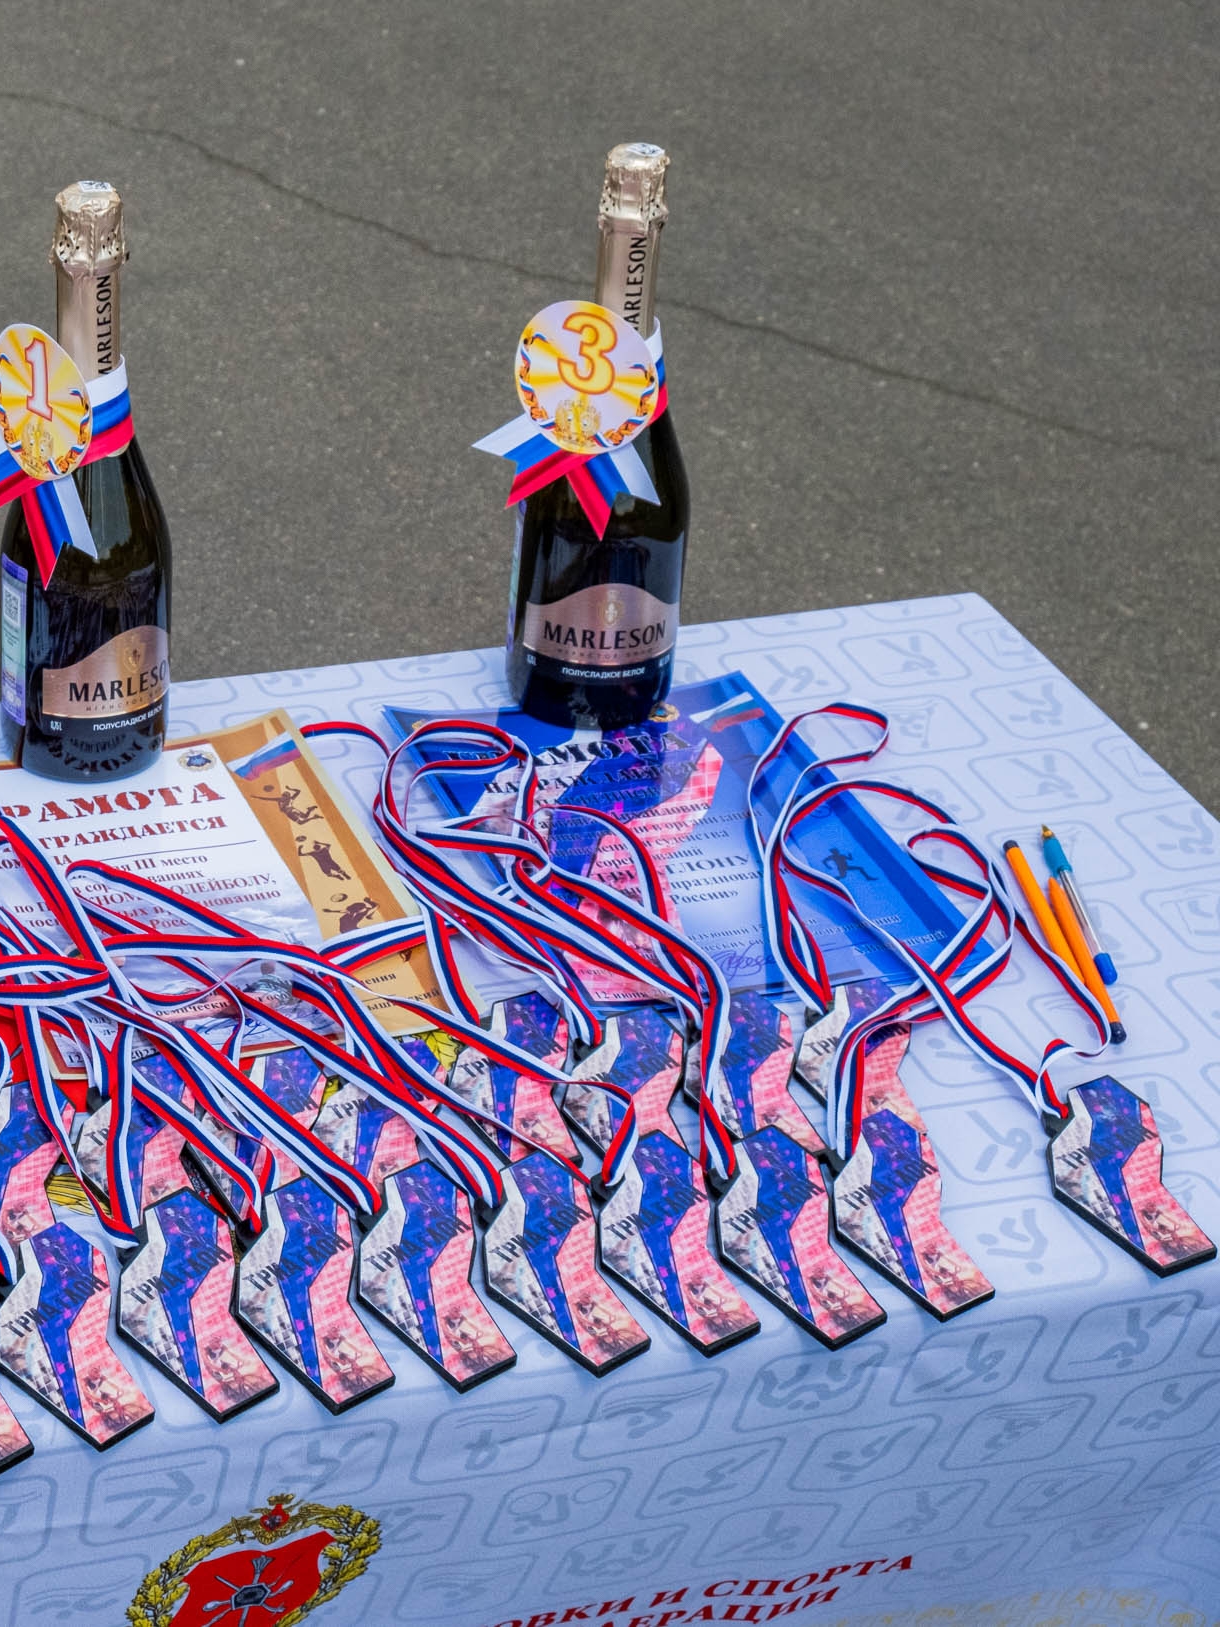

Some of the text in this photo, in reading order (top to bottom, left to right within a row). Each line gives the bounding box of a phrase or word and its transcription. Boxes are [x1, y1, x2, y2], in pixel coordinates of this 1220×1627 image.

[624, 237, 647, 336] ARLESON
[24, 338, 53, 422] 1
[557, 312, 618, 395] 3
[544, 620, 666, 650] MARLESON
[69, 659, 167, 703] MARLESO
[561, 666, 646, 679] ПОЛУСЛАДКОЕ БЕЛОЕ
[93, 713, 147, 732] ПОЛУСЛАДКОЕ
[37, 815, 227, 850] ГРАЖДАЕТСЯ
[159, 854, 208, 868] место
[169, 872, 277, 896] ОЛЕЙБОЛУ,
[604, 1185, 708, 1241] ТРИАТЛОН
[724, 1179, 826, 1235] ТРИАТЛОН
[838, 1159, 938, 1211] ТРИАТЛОН
[362, 1215, 472, 1274] ТРИАТЛОН
[489, 1202, 592, 1264] ТРИАТЛОН
[124, 1245, 232, 1305] ТРИАТЛОН
[242, 1230, 353, 1293] ТРИАТЛОН
[1, 1275, 109, 1339] ТРИАТЛОН
[649, 1586, 690, 1607] И
[703, 1555, 914, 1599] СПОРТА
